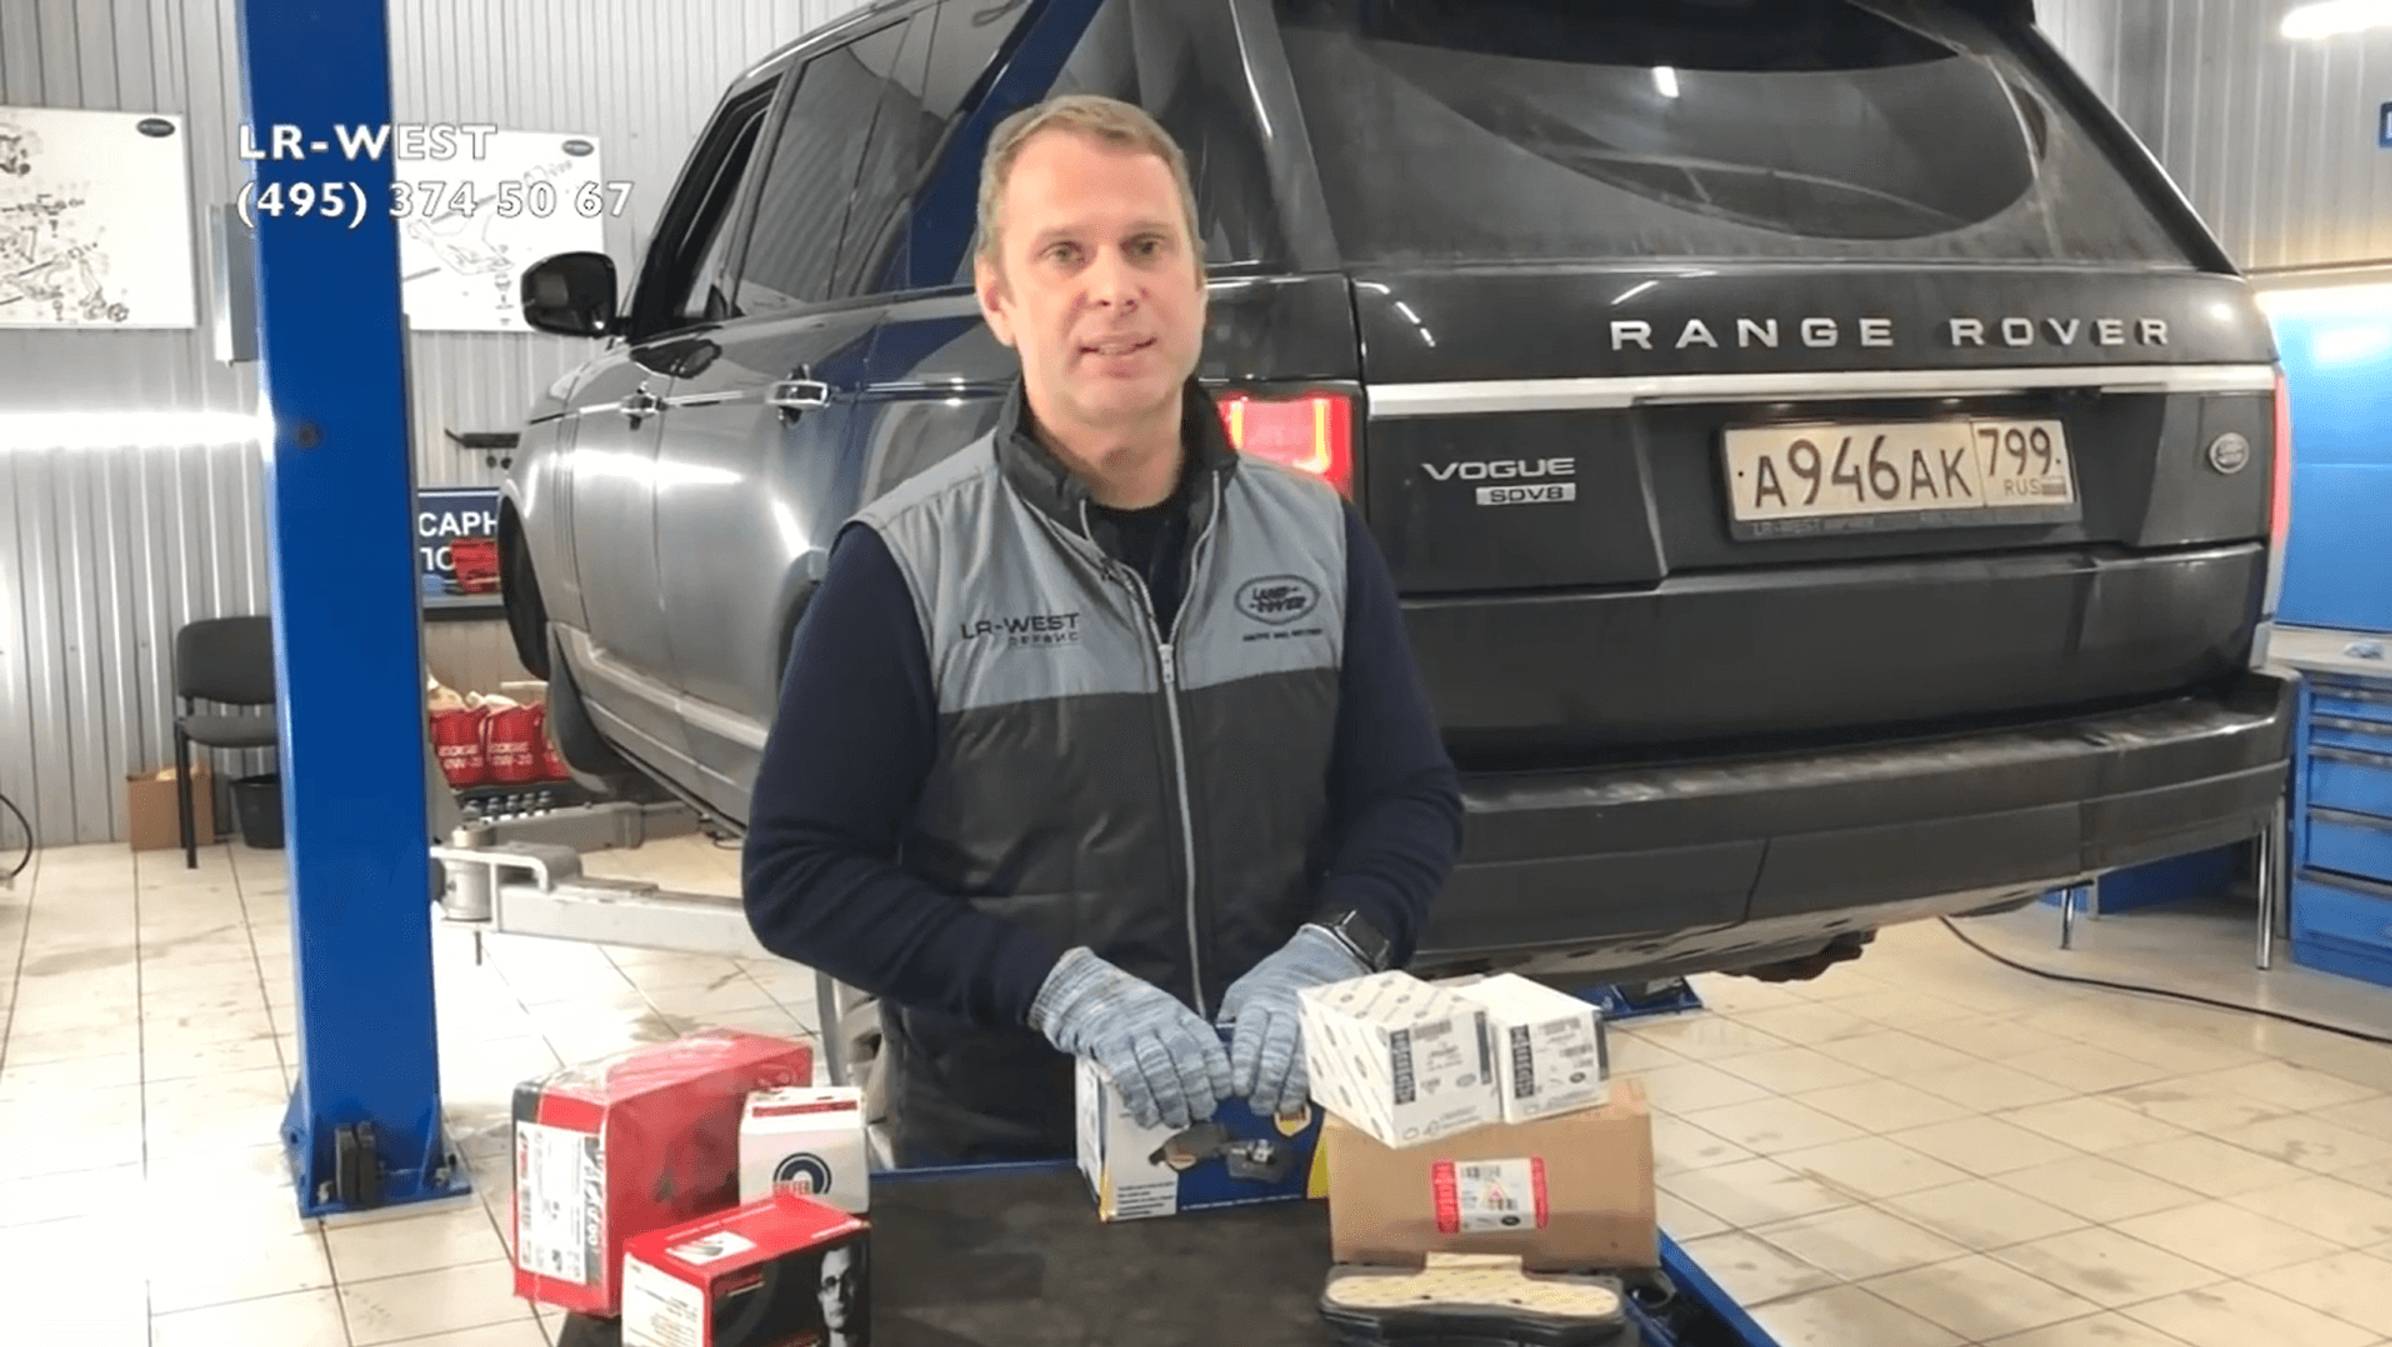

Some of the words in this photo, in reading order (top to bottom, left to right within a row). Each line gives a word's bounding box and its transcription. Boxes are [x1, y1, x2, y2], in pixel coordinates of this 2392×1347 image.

[1610, 317, 1895, 350] RANGE
[1949, 316, 2168, 347] ROVER
[1977, 426, 2052, 477] 799
[1420, 457, 1576, 481] VOGUE
[1489, 486, 1565, 503] SDV8
[2004, 477, 2042, 497] RUS
[960, 611, 1080, 639] LR-WEST
